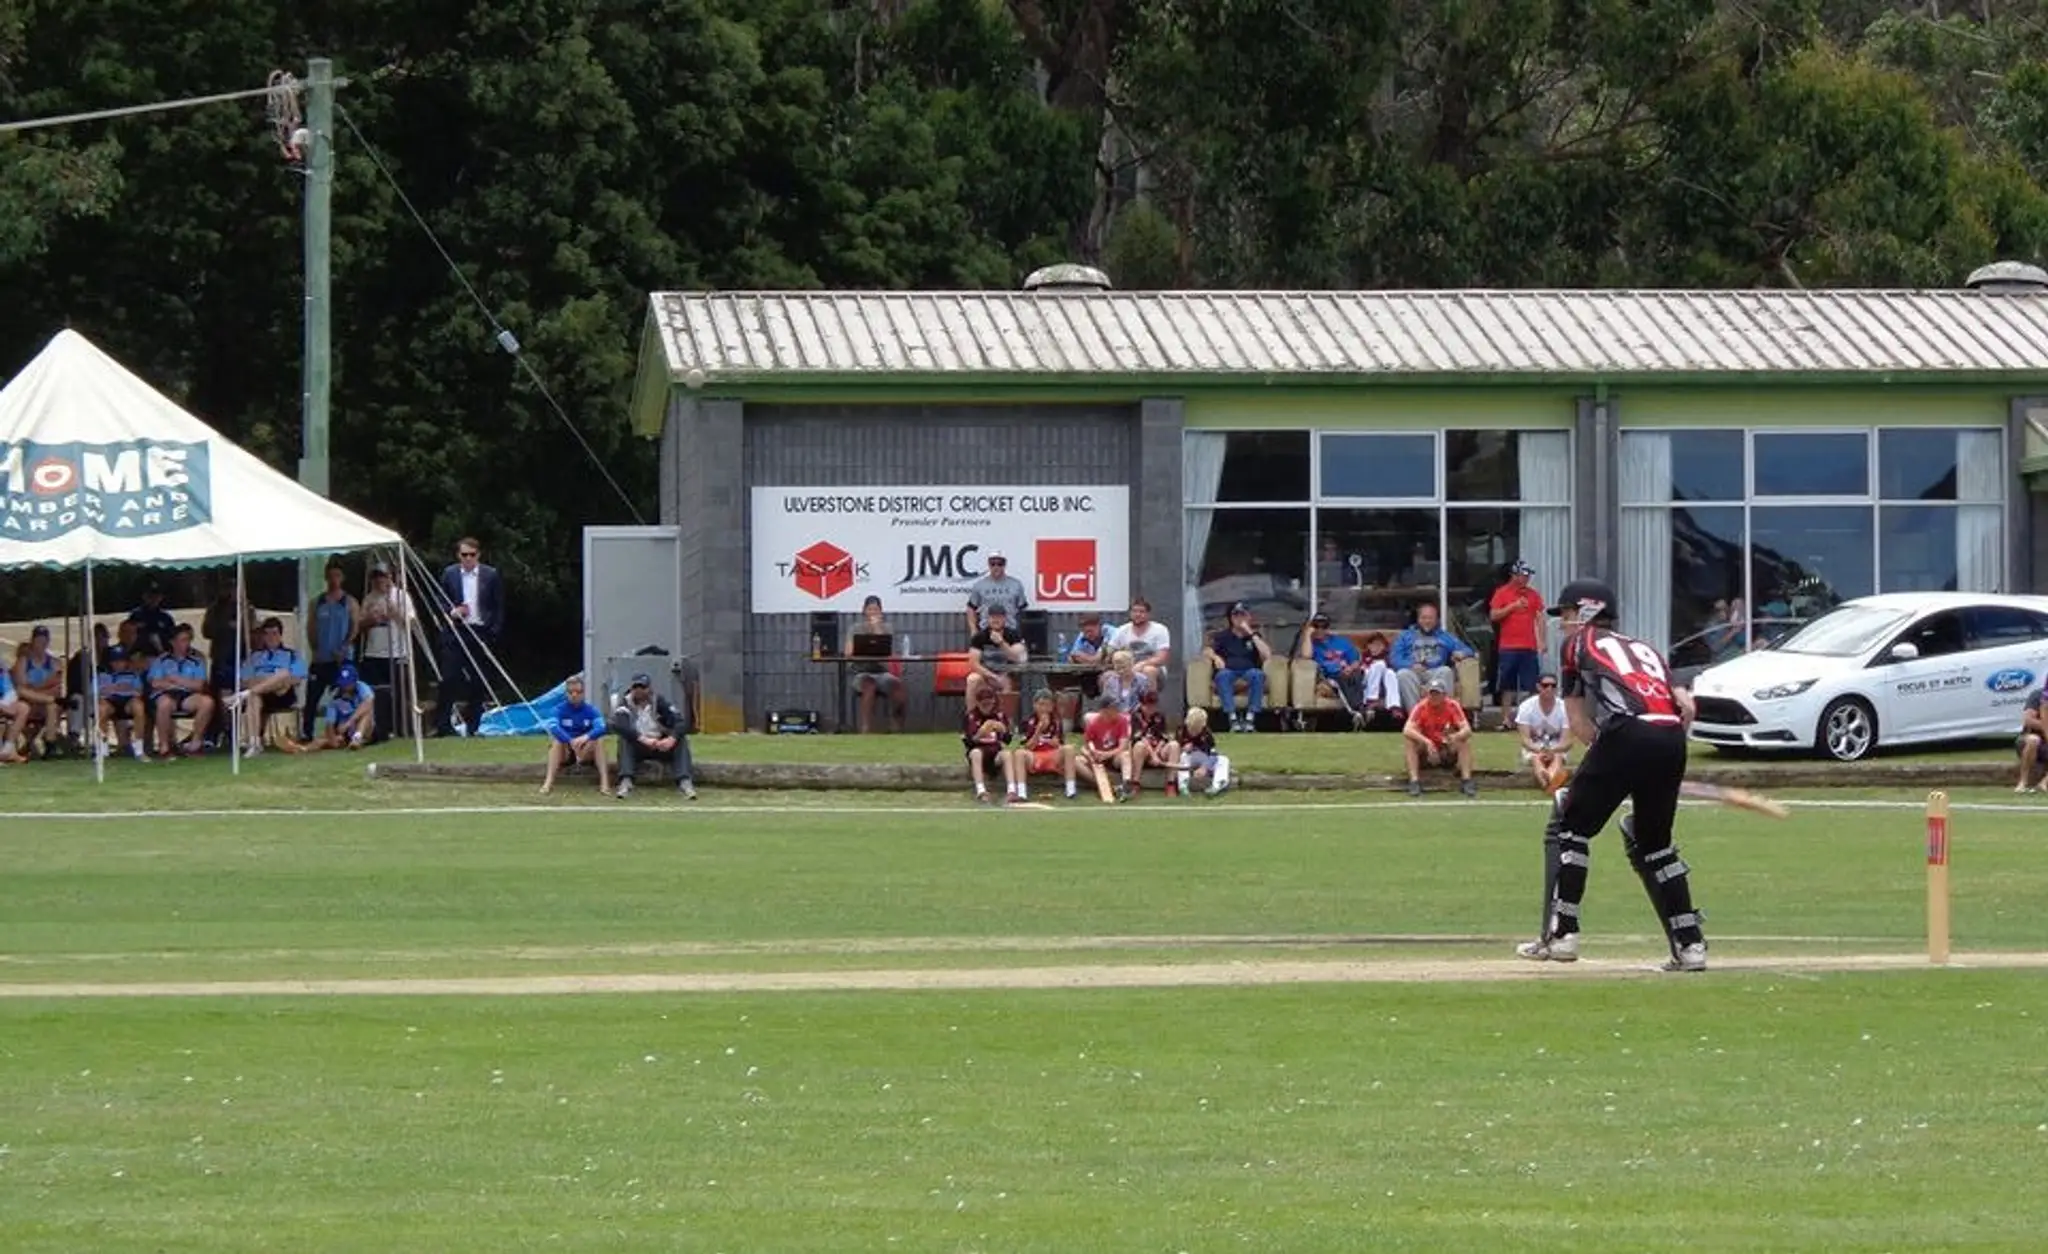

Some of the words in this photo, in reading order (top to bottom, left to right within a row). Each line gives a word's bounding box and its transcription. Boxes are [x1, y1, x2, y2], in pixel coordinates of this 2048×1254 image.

[784, 496, 874, 513] ULVERSTONE
[878, 496, 943, 513] DISTRICT
[949, 495, 1014, 513] CRICKET
[1019, 495, 1060, 512] CLUB
[775, 562, 870, 577] TASPAK
[899, 544, 979, 582] JMC
[1595, 636, 1667, 682] 19
